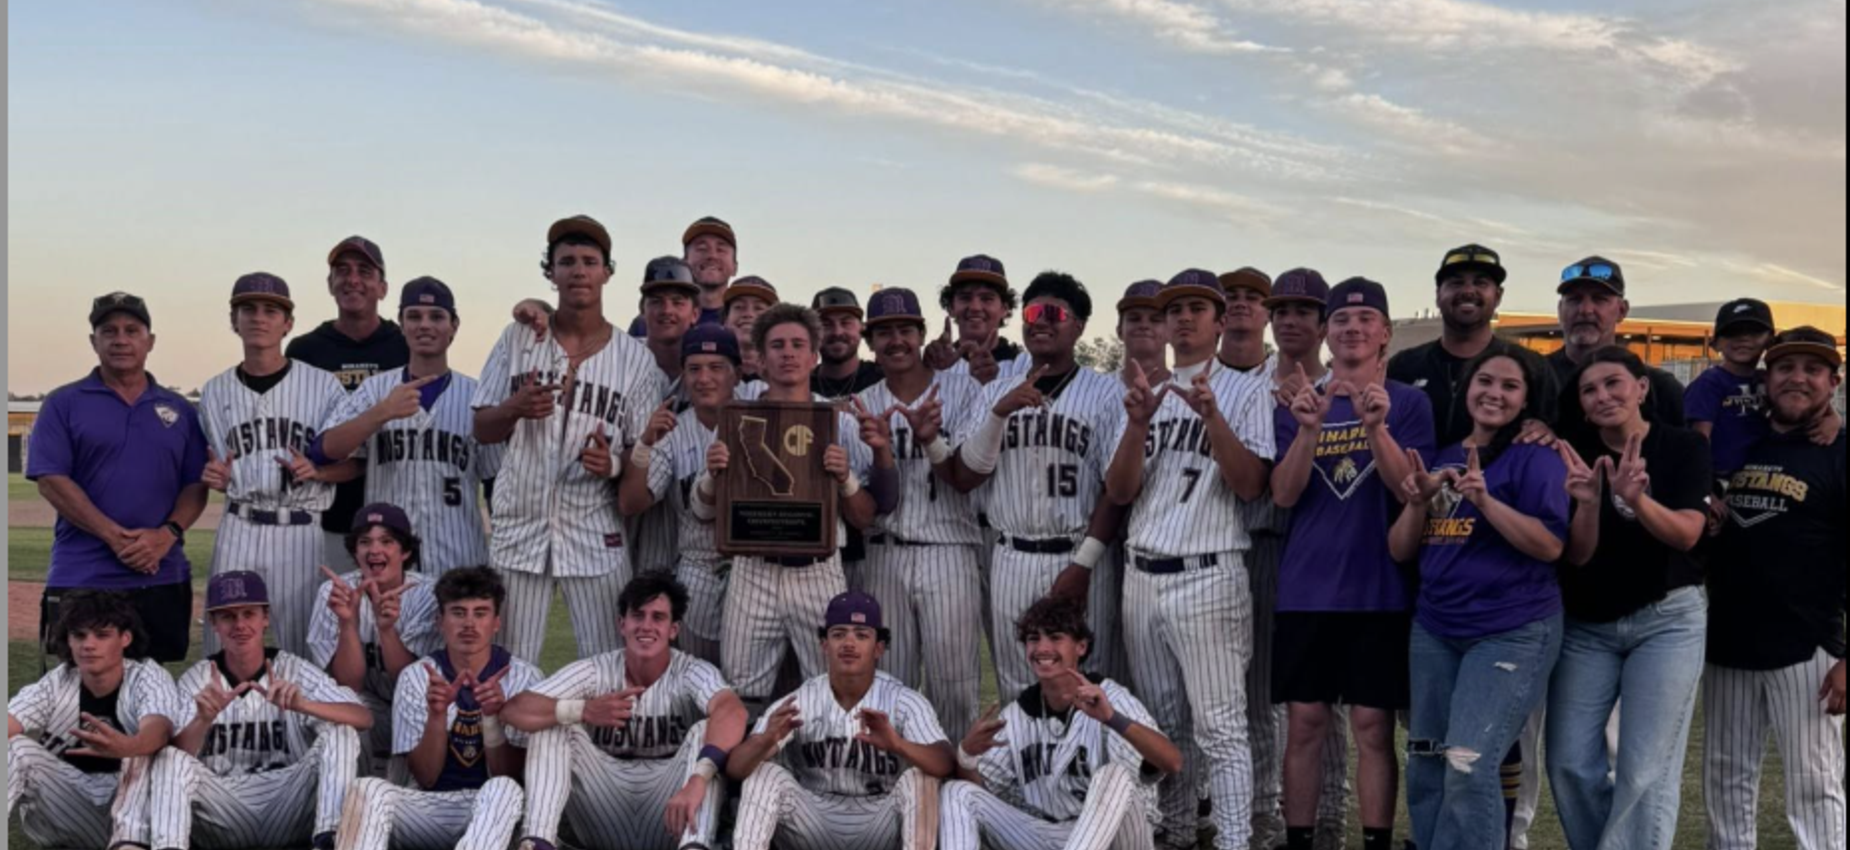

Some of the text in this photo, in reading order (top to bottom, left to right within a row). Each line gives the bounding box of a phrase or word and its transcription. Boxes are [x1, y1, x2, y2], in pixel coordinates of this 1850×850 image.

[1000, 410, 1090, 458] STANGS
[1315, 441, 1370, 457] BASEBAL
[443, 477, 463, 507] 5
[1047, 463, 1078, 498] 15
[1180, 468, 1202, 503] 7
[1731, 470, 1809, 502] STANGS
